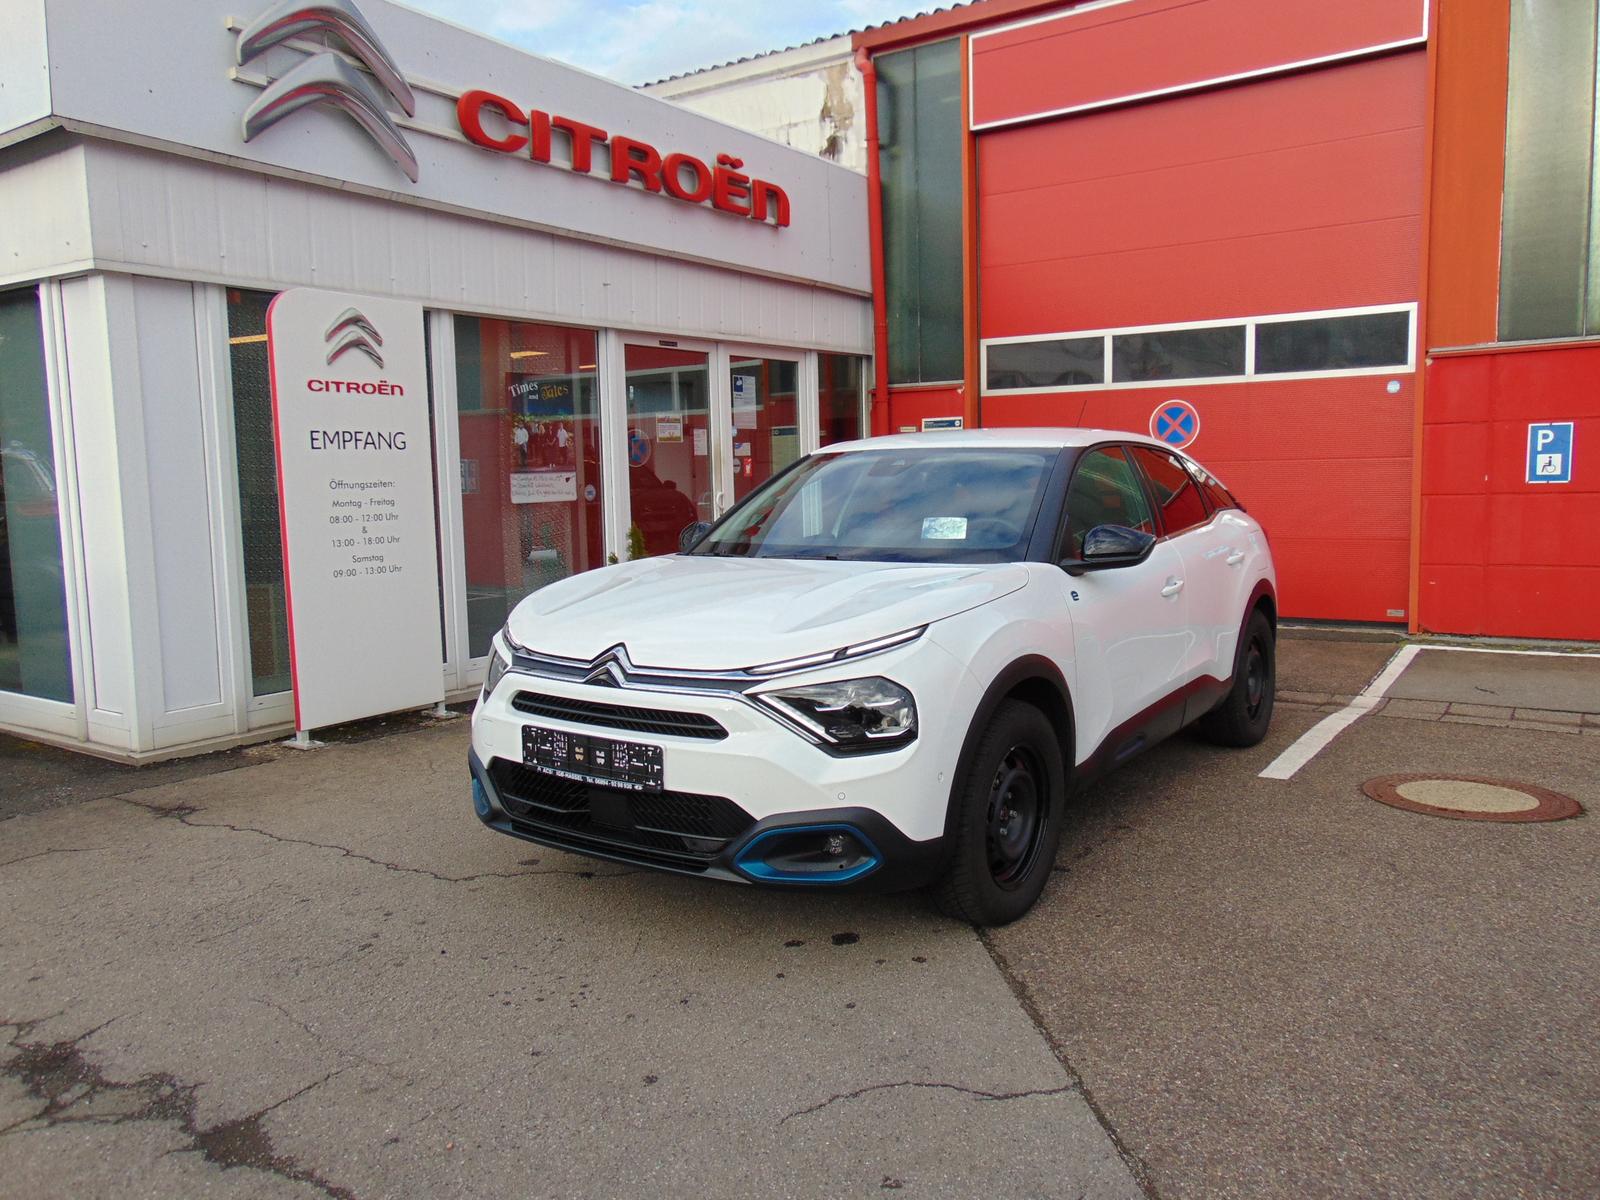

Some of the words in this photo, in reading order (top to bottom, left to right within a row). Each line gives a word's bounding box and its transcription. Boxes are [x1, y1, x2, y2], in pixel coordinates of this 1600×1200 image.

[455, 88, 791, 229] CITROËN
[307, 379, 404, 397] CITROËN
[508, 381, 539, 397] Times
[541, 384, 569, 401] Tales
[310, 430, 407, 451] EMPFANG
[1537, 429, 1554, 452] P
[329, 478, 396, 491] Öffnungszeiten:
[332, 499, 362, 509] Montag
[369, 497, 395, 507] Freitag
[329, 515, 353, 524] 08:00
[361, 513, 384, 523] 12:00
[385, 512, 399, 521] Uhr
[361, 526, 368, 534] &
[332, 538, 355, 548] 13:00
[363, 536, 385, 545] 18:00
[386, 535, 401, 544] Uhr
[352, 554, 384, 563] Samstag
[333, 568, 357, 578] 09:00
[365, 566, 387, 575] 13:00
[388, 564, 402, 573] Uhr
